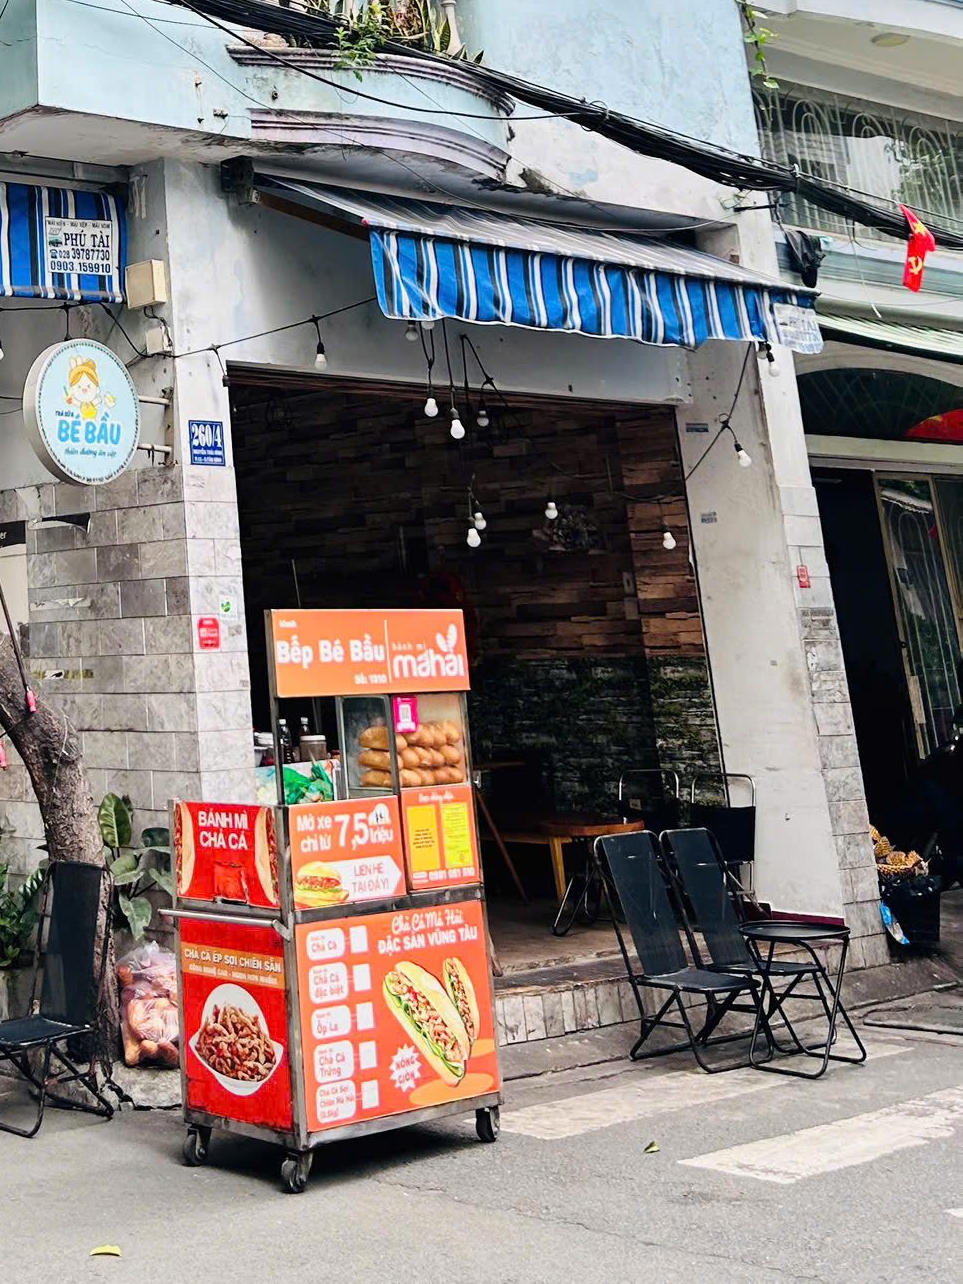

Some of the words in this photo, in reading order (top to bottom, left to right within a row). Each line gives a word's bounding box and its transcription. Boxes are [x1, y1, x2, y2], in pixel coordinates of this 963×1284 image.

[63, 230, 86, 247] PHÚ
[91, 230, 110, 248] TÀI
[59, 250, 70, 259] 028
[71, 248, 110, 261] 39787730
[58, 414, 82, 443] BÉ
[85, 412, 122, 445] BẦU
[191, 424, 222, 447] 260/4
[277, 634, 314, 669] Bếp
[319, 640, 345, 663] Bé
[349, 633, 385, 662] Bầu
[199, 808, 233, 828] BÁNH
[235, 810, 249, 829] MÌ
[297, 813, 315, 832] Mở
[317, 816, 332, 830] xe
[199, 828, 227, 849] CHẢ
[229, 830, 248, 851] CÁ
[301, 836, 318, 852] chỉ
[319, 833, 332, 851] từ
[334, 812, 369, 851] 7,5
[369, 826, 394, 844] triệu
[378, 934, 401, 956] ĐẶC
[403, 930, 426, 951] SẢN
[428, 928, 456, 946] VŨNG
[457, 924, 478, 942] TÀU
[185, 947, 199, 960] CHẢ
[201, 950, 211, 962] CÁ
[239, 957, 262, 970] CHIÊN
